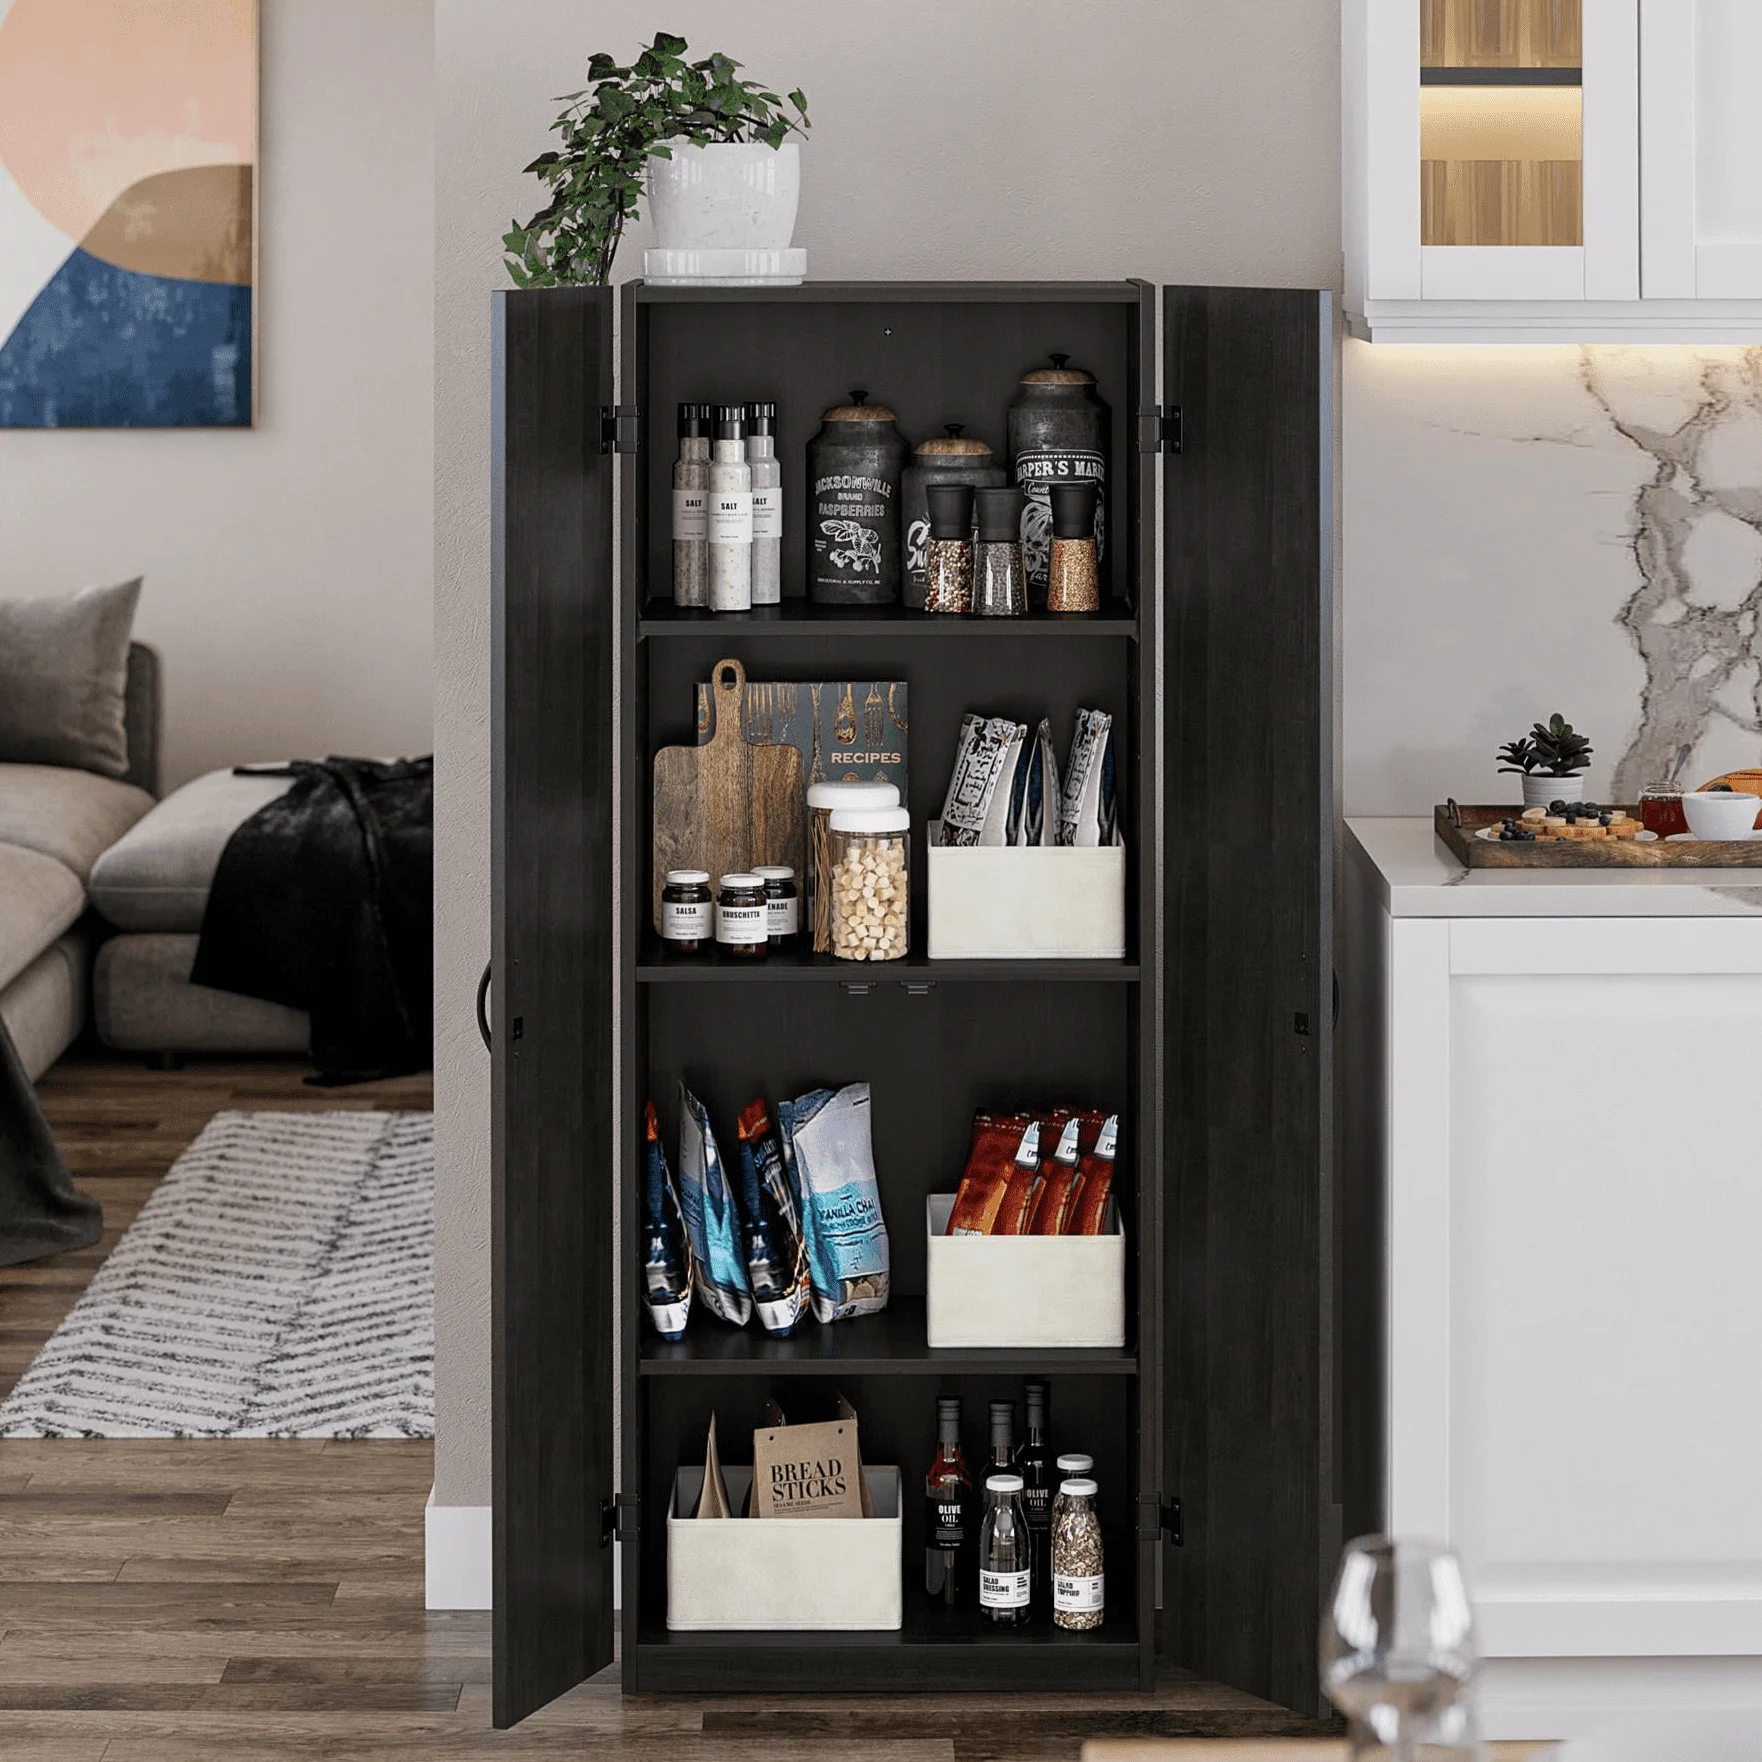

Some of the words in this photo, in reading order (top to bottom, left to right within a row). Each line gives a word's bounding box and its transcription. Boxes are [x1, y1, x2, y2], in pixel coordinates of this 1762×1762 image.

[837, 493, 863, 501] BRAND
[818, 502, 885, 517] RASPBERRIES
[831, 752, 902, 764] RECIPES
[675, 906, 697, 915] SALSA
[722, 910, 760, 919] BRUSCHETTA
[818, 1203, 855, 1220] VANILLA
[771, 1459, 842, 1483] BREAD
[772, 1476, 847, 1501] STICKS
[1026, 1489, 1049, 1498] OLIVE
[1030, 1499, 1047, 1507] OIL
[938, 1505, 961, 1514] OLIVE
[941, 1515, 959, 1523] OIL
[983, 1583, 1010, 1592] DRESSING
[1057, 1587, 1080, 1597] TOPPING
